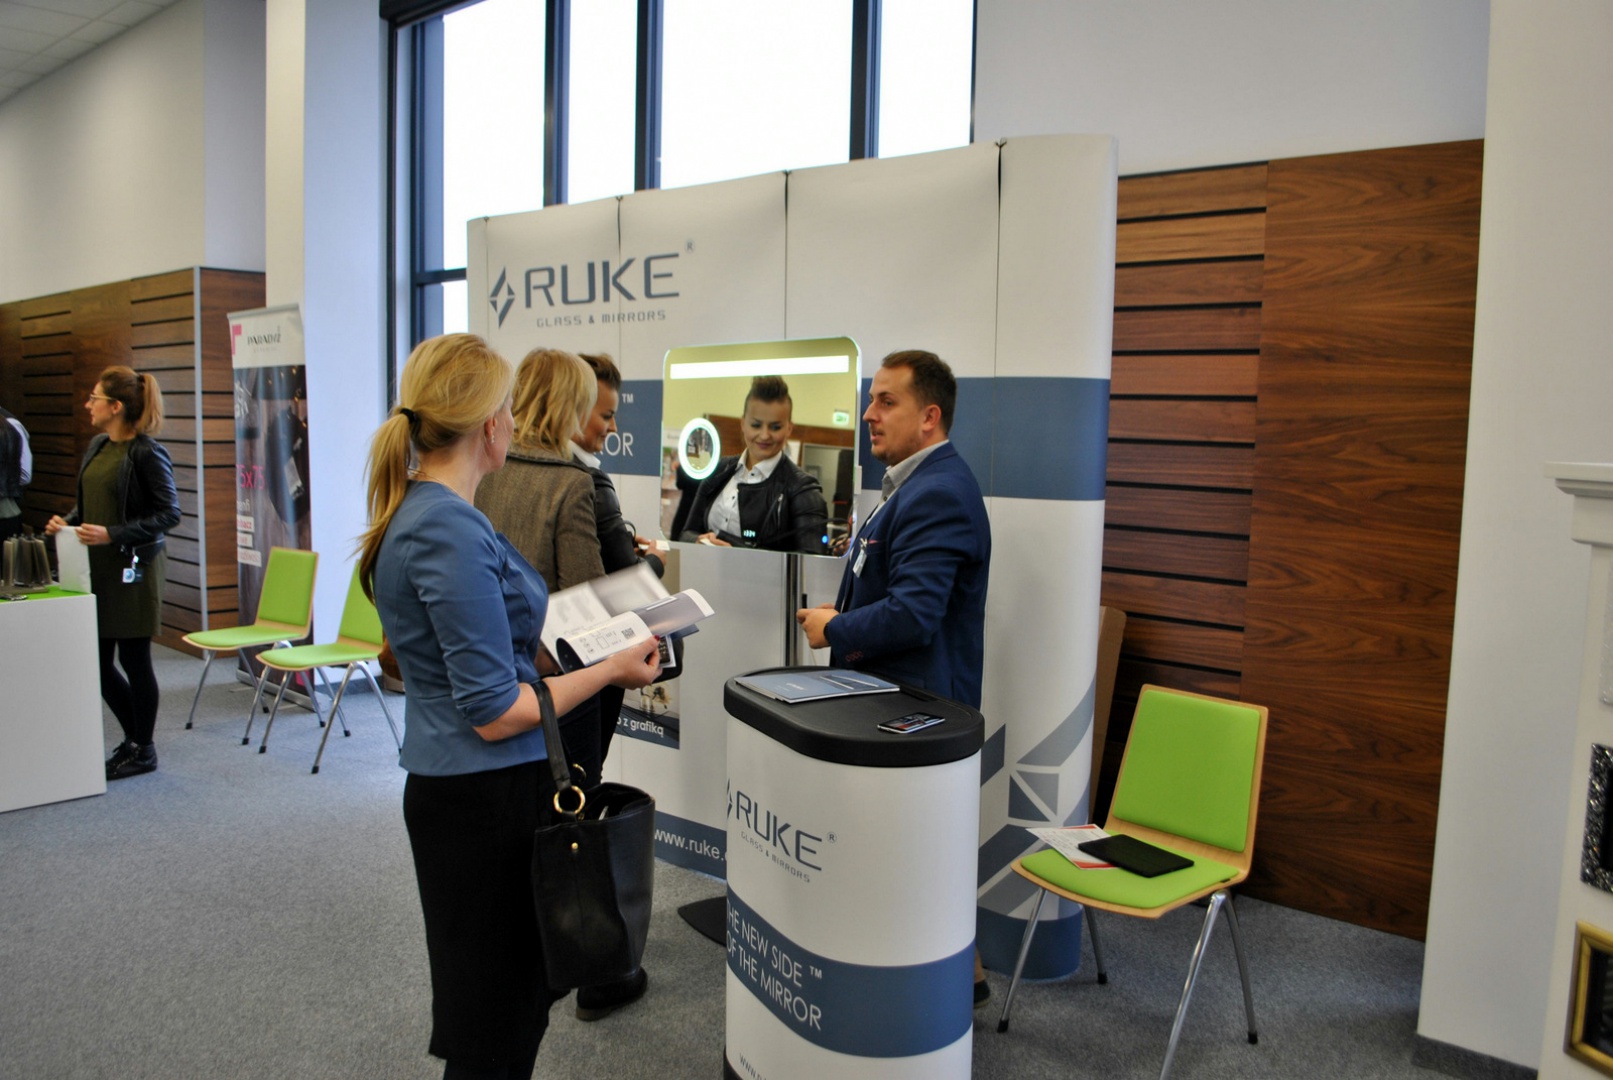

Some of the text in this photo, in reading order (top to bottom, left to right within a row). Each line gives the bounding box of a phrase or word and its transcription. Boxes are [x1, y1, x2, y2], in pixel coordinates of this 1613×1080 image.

[524, 252, 680, 309] RUKE
[536, 310, 667, 328] GLASS & MIRRORS
[593, 432, 633, 456] OR
[630, 719, 664, 739] grafiką
[654, 828, 727, 862] www.ruke.
[736, 790, 823, 872] RUKE
[741, 831, 764, 853] GLASS
[771, 853, 811, 883] MIRRORS
[741, 918, 769, 959] NEW
[771, 944, 803, 988] SIDE
[726, 930, 822, 1032] OF THE MIRROR
